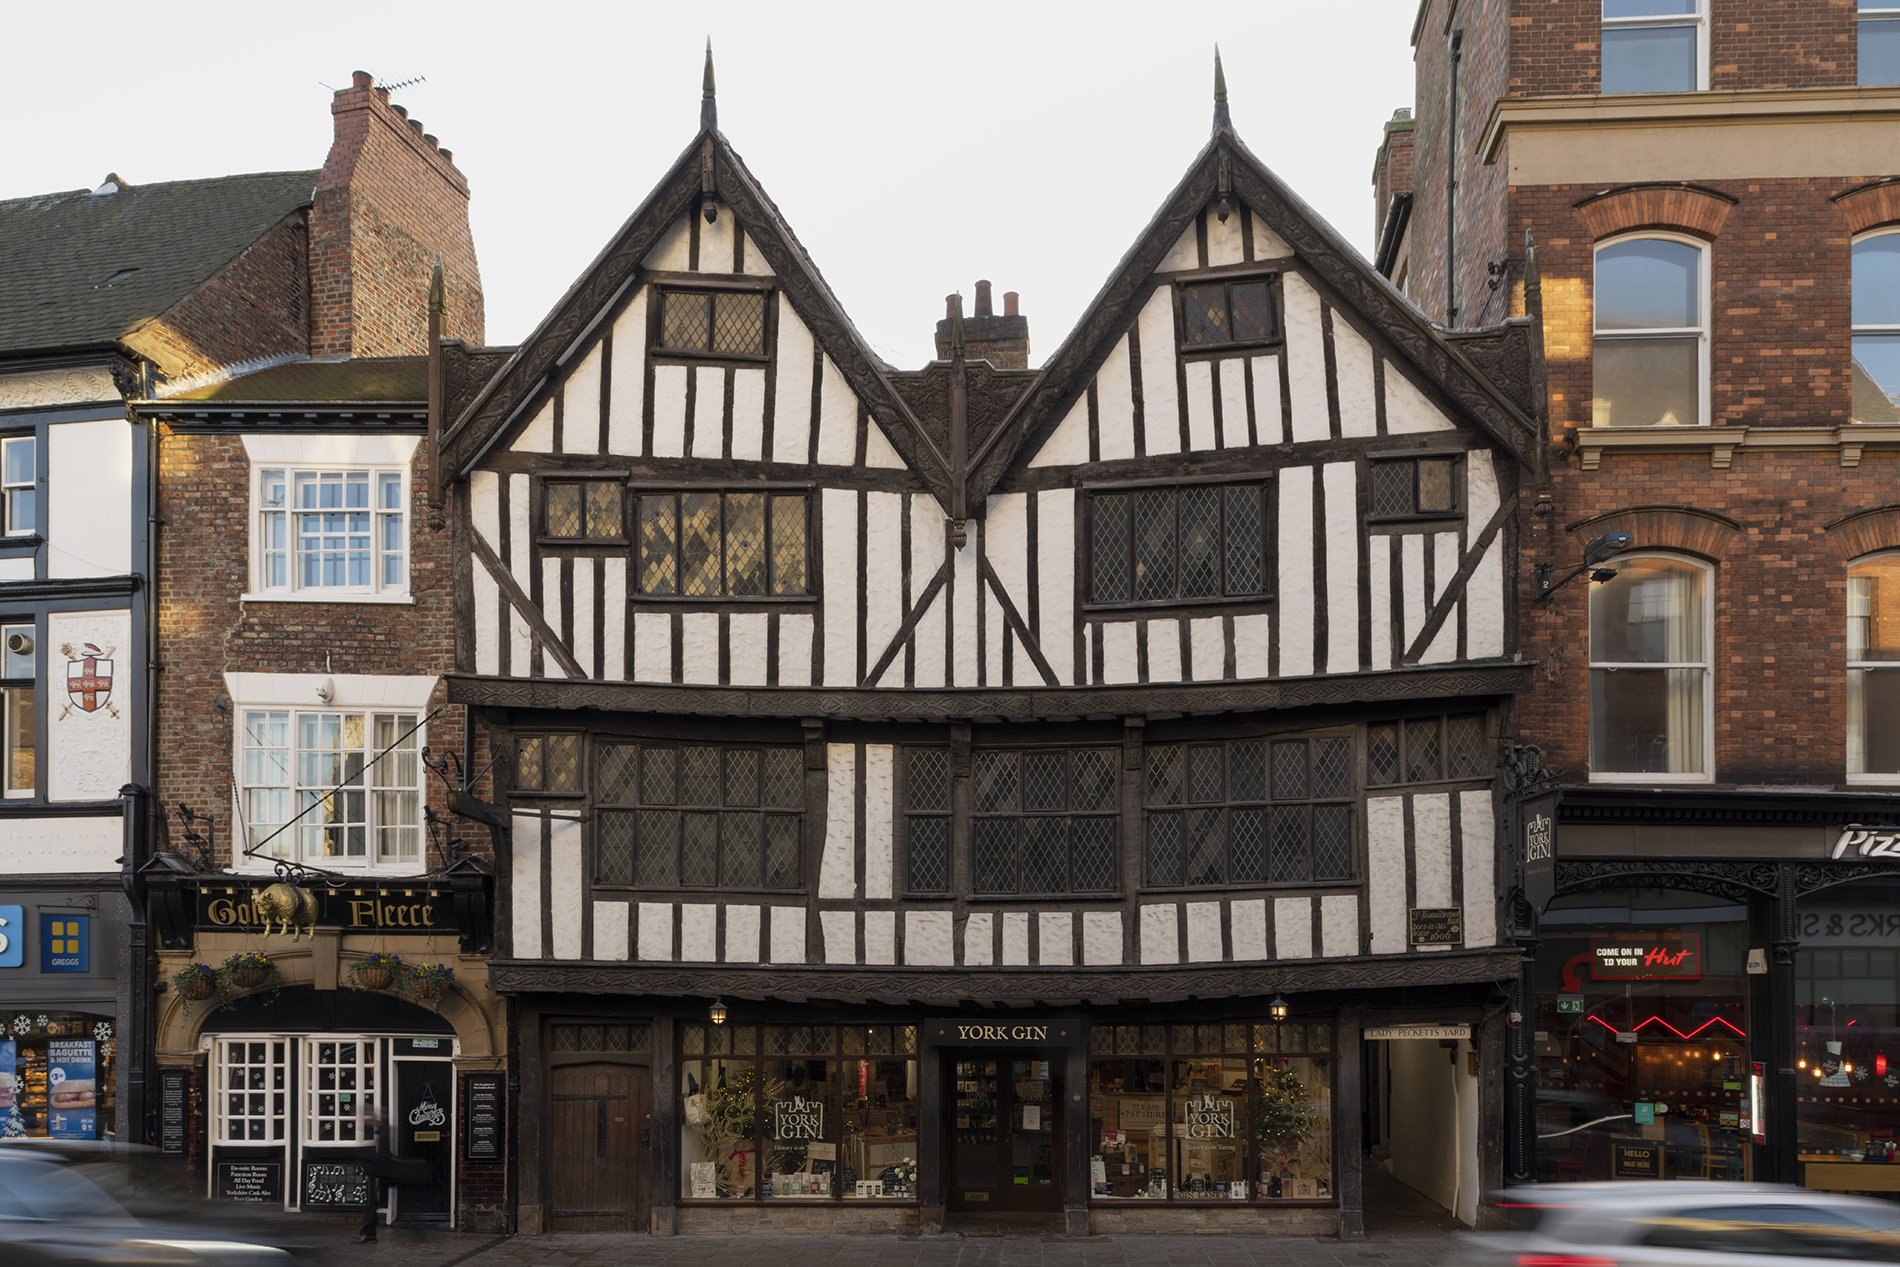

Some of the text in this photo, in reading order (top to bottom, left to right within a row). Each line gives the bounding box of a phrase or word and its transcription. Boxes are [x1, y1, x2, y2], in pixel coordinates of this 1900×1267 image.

[1542, 580, 1549, 589] 2
[1529, 832, 1549, 846] YORK
[1530, 844, 1548, 860] GIN
[347, 900, 434, 928] Fleece
[1430, 930, 1451, 940] 1606
[52, 958, 79, 966] GREGGS
[1596, 947, 1694, 966] COME ON IN Hut
[1604, 958, 1638, 966] TO YOUR
[958, 1026, 1048, 1040] YORK GIN
[419, 1100, 437, 1110] Merry
[408, 1106, 446, 1128] Christmas
[780, 1114, 820, 1126] YORK
[1190, 1113, 1230, 1125] YORK
[780, 1125, 817, 1139] GIN
[1190, 1124, 1229, 1138] GIN
[1624, 1150, 1650, 1158] HELLO
